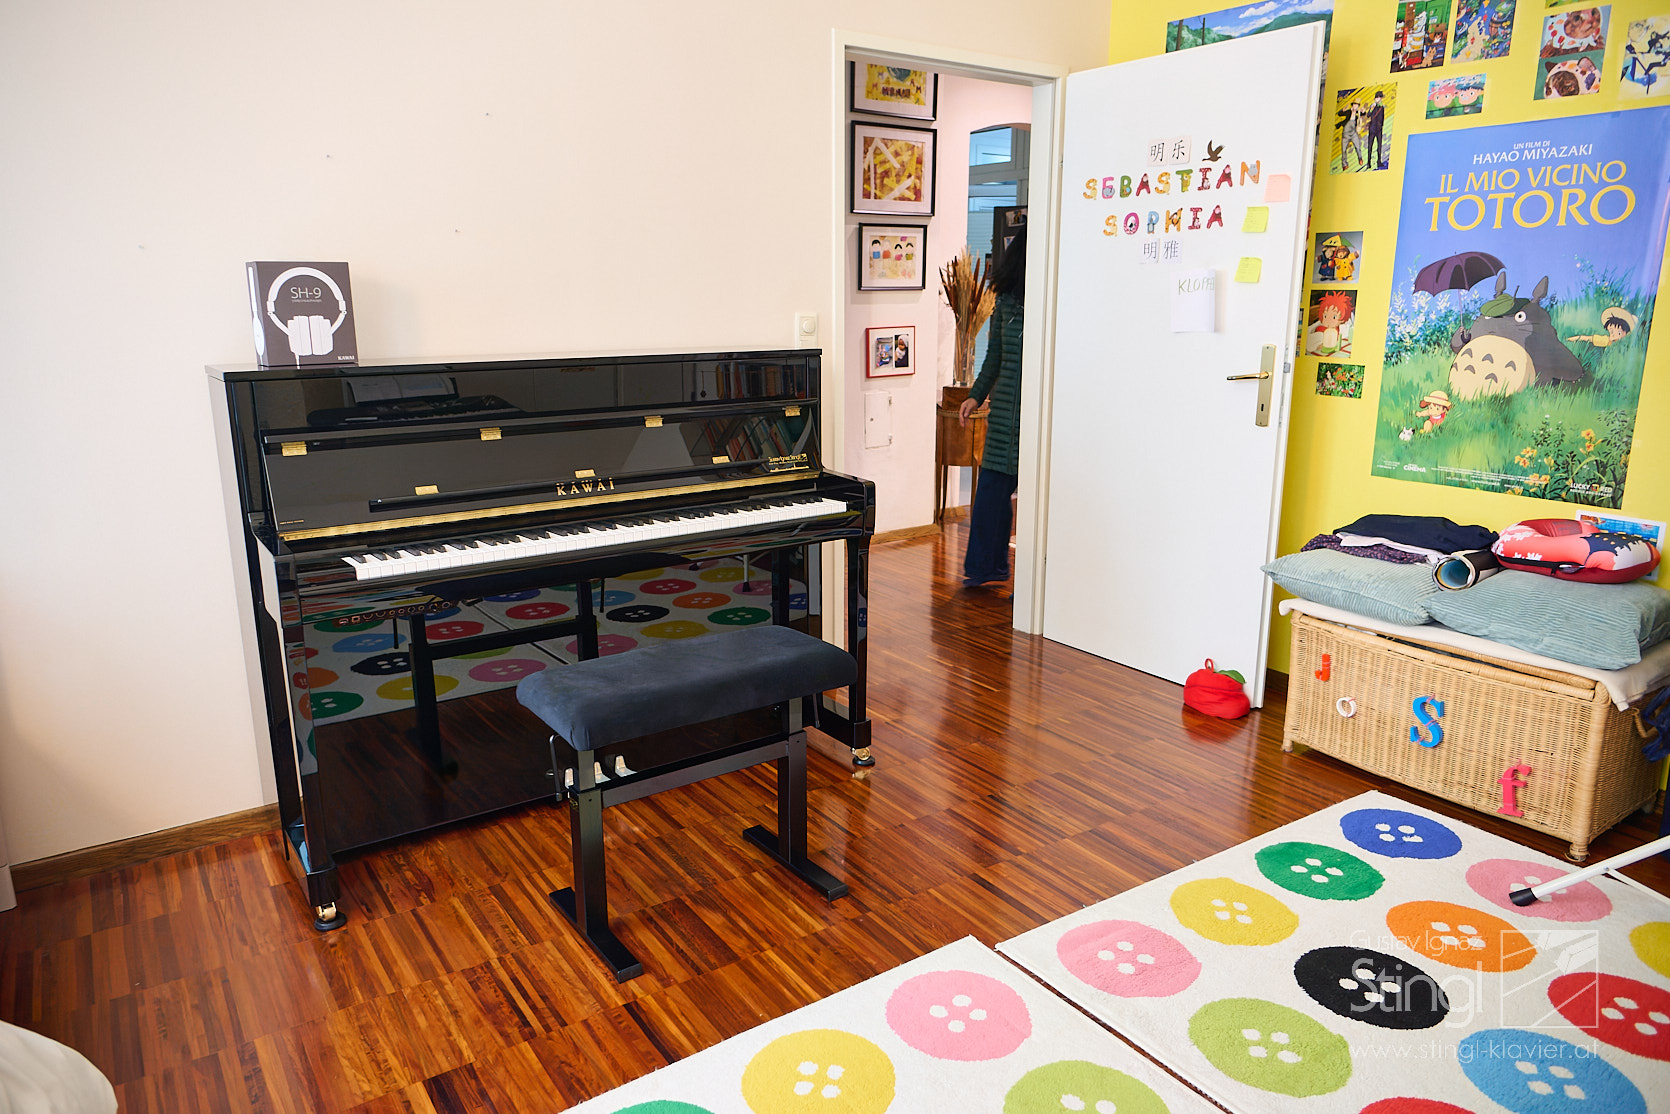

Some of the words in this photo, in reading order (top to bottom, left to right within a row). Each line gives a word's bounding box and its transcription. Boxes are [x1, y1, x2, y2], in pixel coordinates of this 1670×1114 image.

[1150, 139, 1185, 162] 明乐
[1473, 150, 1520, 165] HAYAO
[1522, 143, 1593, 161] MIYAZAKI
[1525, 141, 1542, 149] FILM
[1082, 159, 1261, 200] SEBASTIAN
[1439, 174, 1459, 194] IL
[1465, 168, 1520, 192] MIO
[1527, 160, 1627, 188] VICINO
[1103, 204, 1224, 237] SOPHIA
[1424, 184, 1636, 232] TOTORO
[1143, 240, 1179, 261] 明雅
[290, 286, 322, 299] SH-9
[555, 477, 615, 496] KAWAI
[1570, 482, 1590, 490] LUCKY
[1315, 653, 1331, 682] J
[1410, 694, 1445, 748] S
[1496, 762, 1532, 818] f
